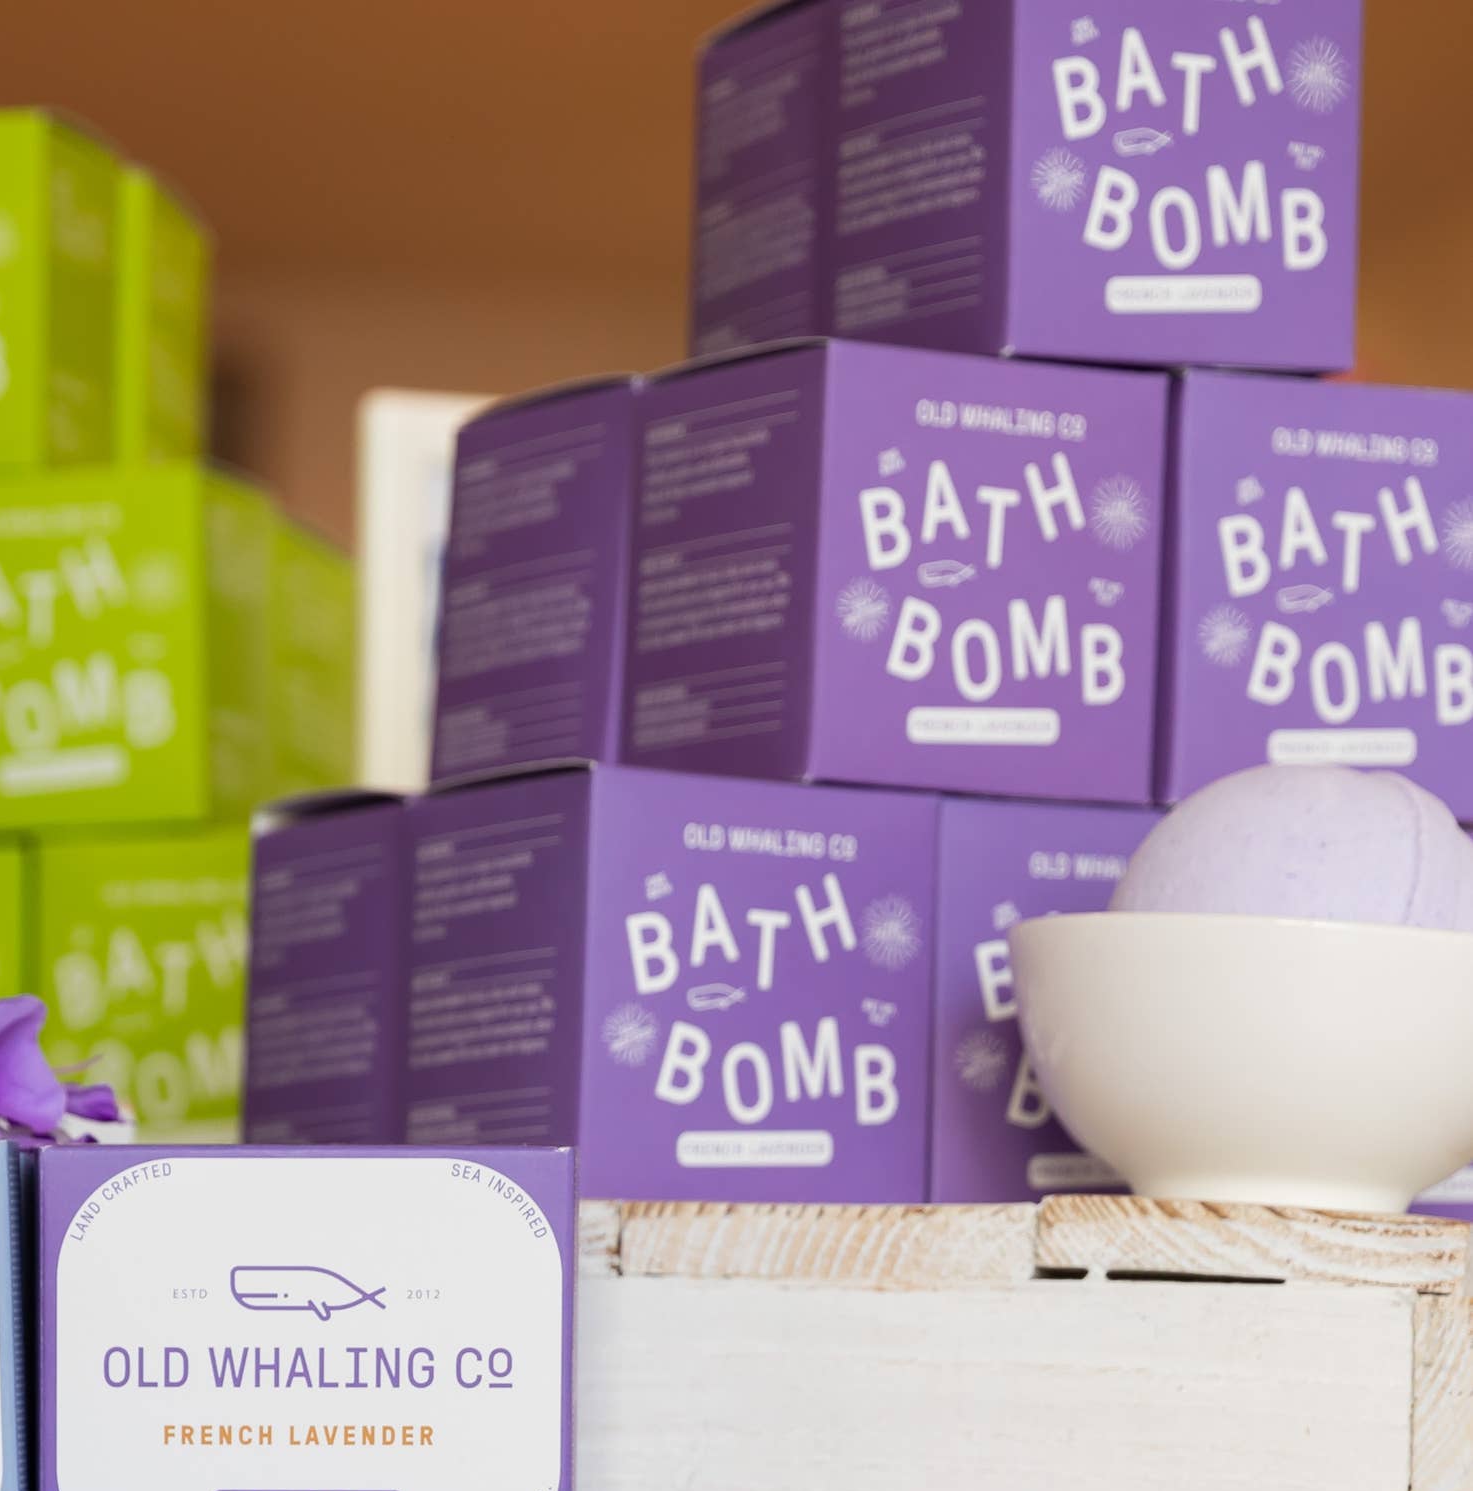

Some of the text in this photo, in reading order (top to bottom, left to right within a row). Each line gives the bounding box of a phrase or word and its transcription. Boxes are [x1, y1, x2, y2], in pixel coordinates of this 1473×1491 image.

[1052, 14, 1284, 140] BATH
[1083, 160, 1327, 271] BOMB
[859, 451, 1086, 571] BATH
[1217, 475, 1439, 597] BATH
[886, 594, 1125, 706] BOMB
[1247, 616, 1473, 725] BOMB
[626, 872, 857, 995] BATH
[655, 1016, 899, 1126] BOMB
[70, 1162, 173, 1241] LAND CRAFTED
[451, 1164, 548, 1240] SEA INSPIRED
[173, 1289, 441, 1299] ESTD 2012
[103, 1346, 189, 1388] OLD
[209, 1346, 435, 1388] WHALING
[163, 1425, 435, 1446] FRENCH LAVENDER
